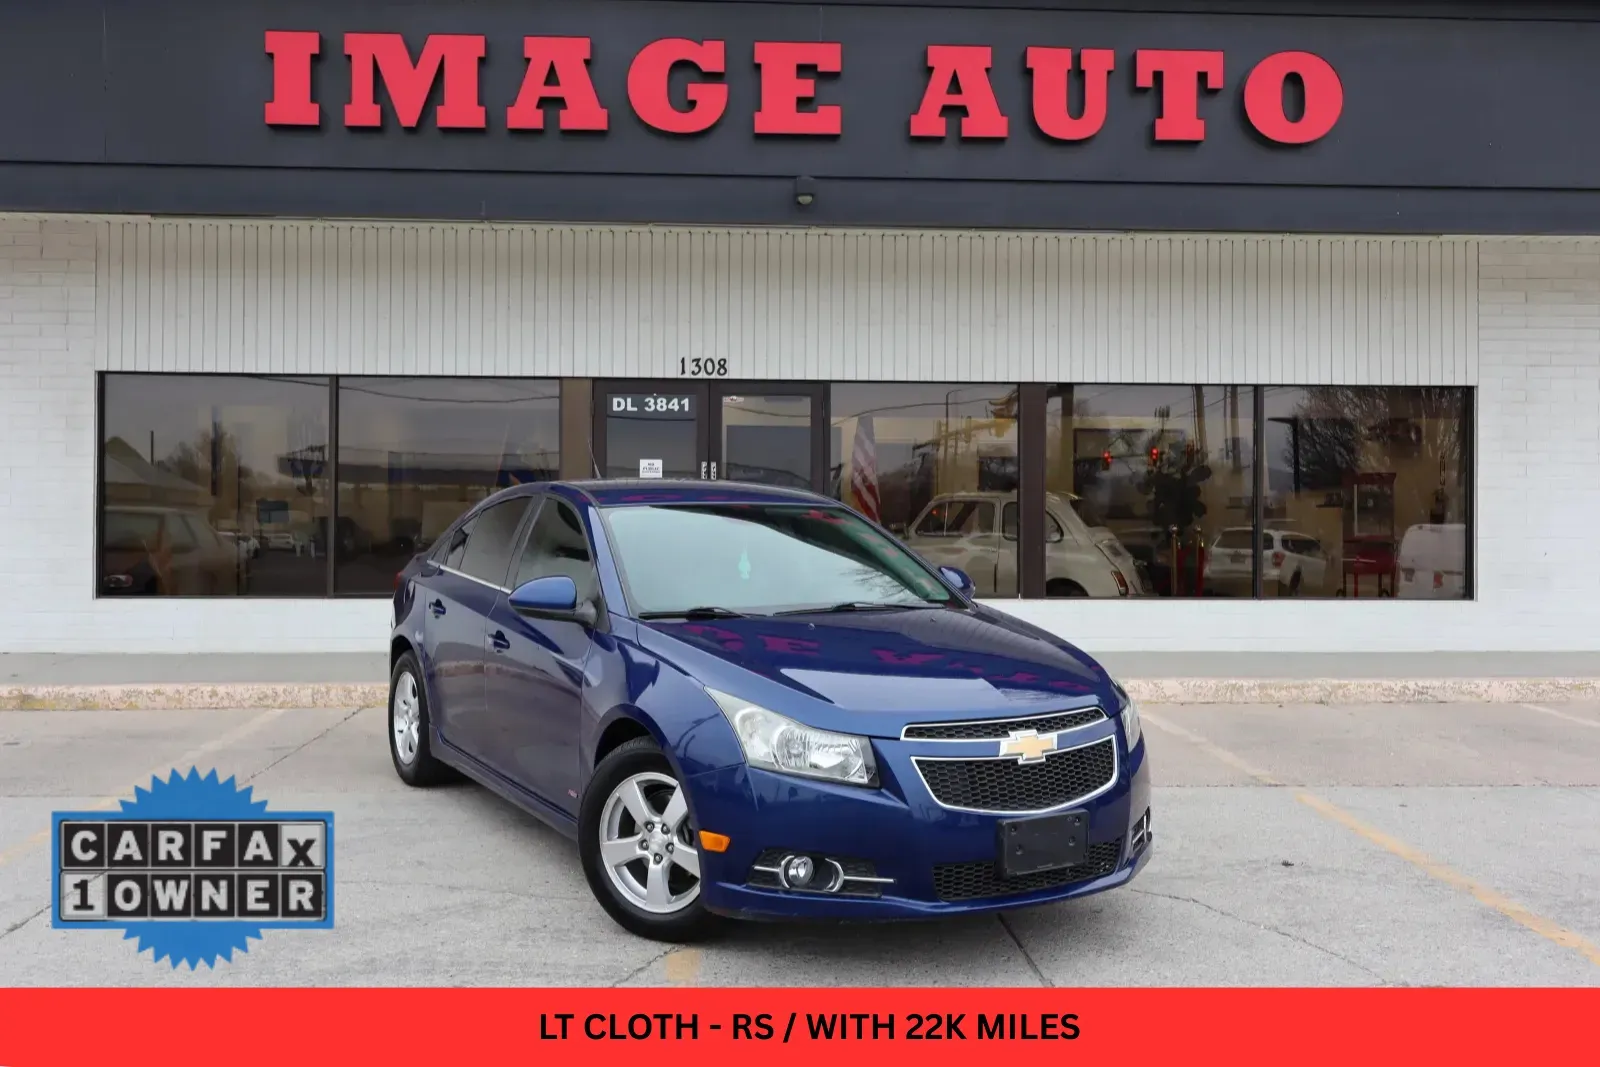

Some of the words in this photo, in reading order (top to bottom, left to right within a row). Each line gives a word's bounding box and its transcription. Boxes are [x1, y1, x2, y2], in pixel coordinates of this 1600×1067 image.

[264, 30, 844, 136] IMAGE
[909, 44, 1344, 145] AUTO
[680, 357, 728, 376] 1308
[612, 397, 638, 412] DL
[644, 397, 690, 412] 3841
